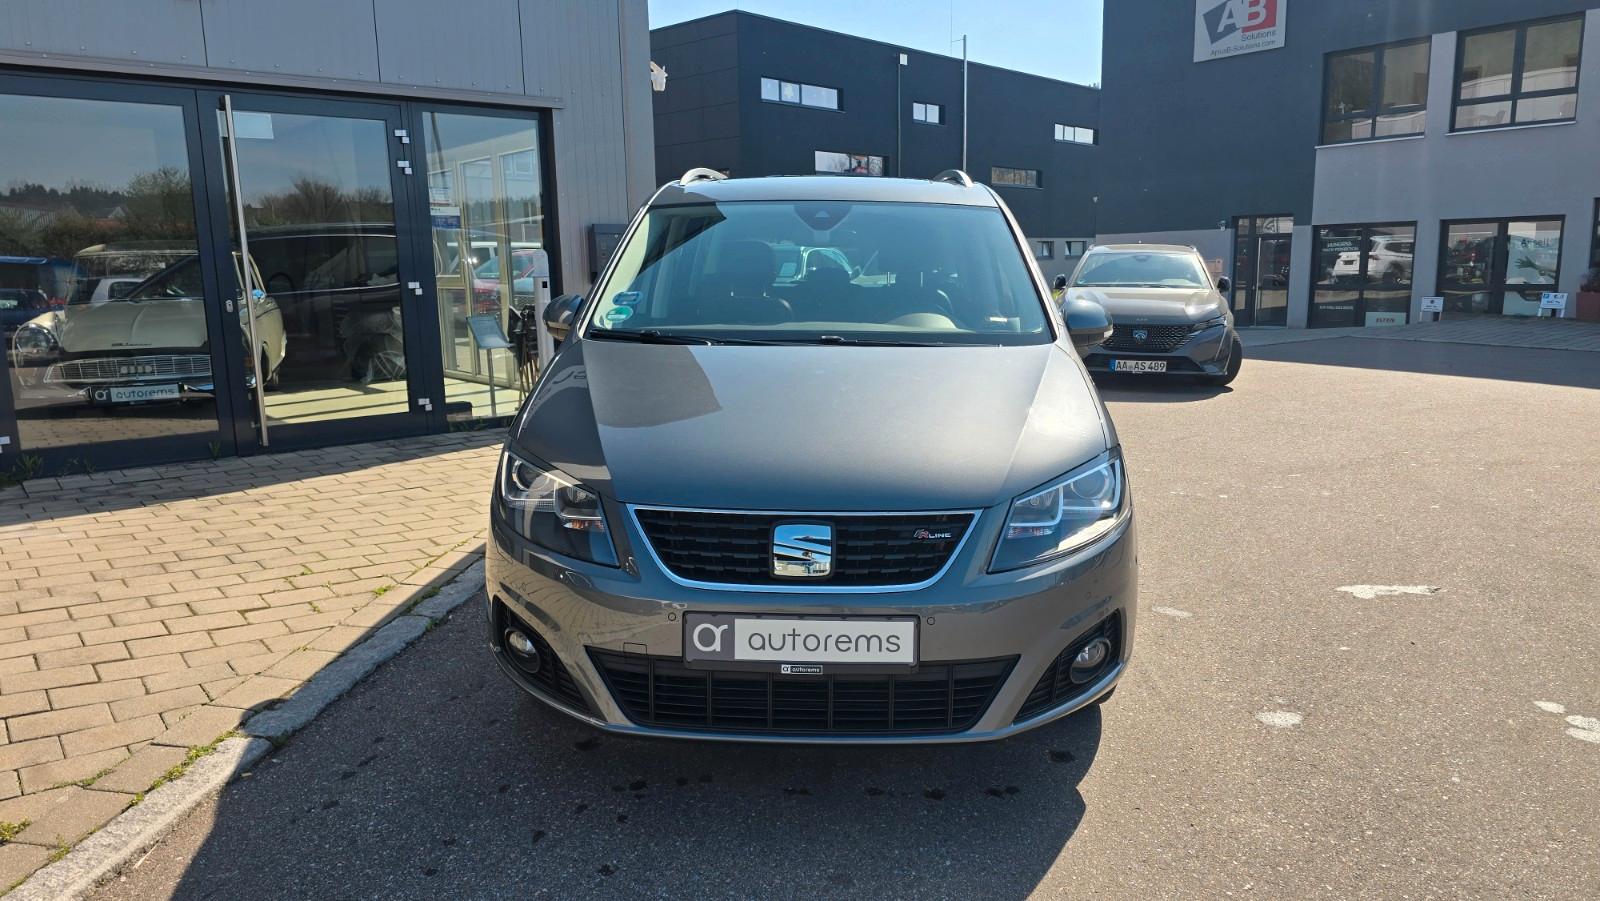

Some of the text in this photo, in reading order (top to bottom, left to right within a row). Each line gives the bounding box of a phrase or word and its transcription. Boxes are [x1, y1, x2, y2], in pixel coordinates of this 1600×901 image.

[1241, 30, 1277, 42] Solutions
[1116, 361, 1166, 371] AA AS 489
[116, 388, 175, 400] autorems
[748, 628, 901, 653] autorems
